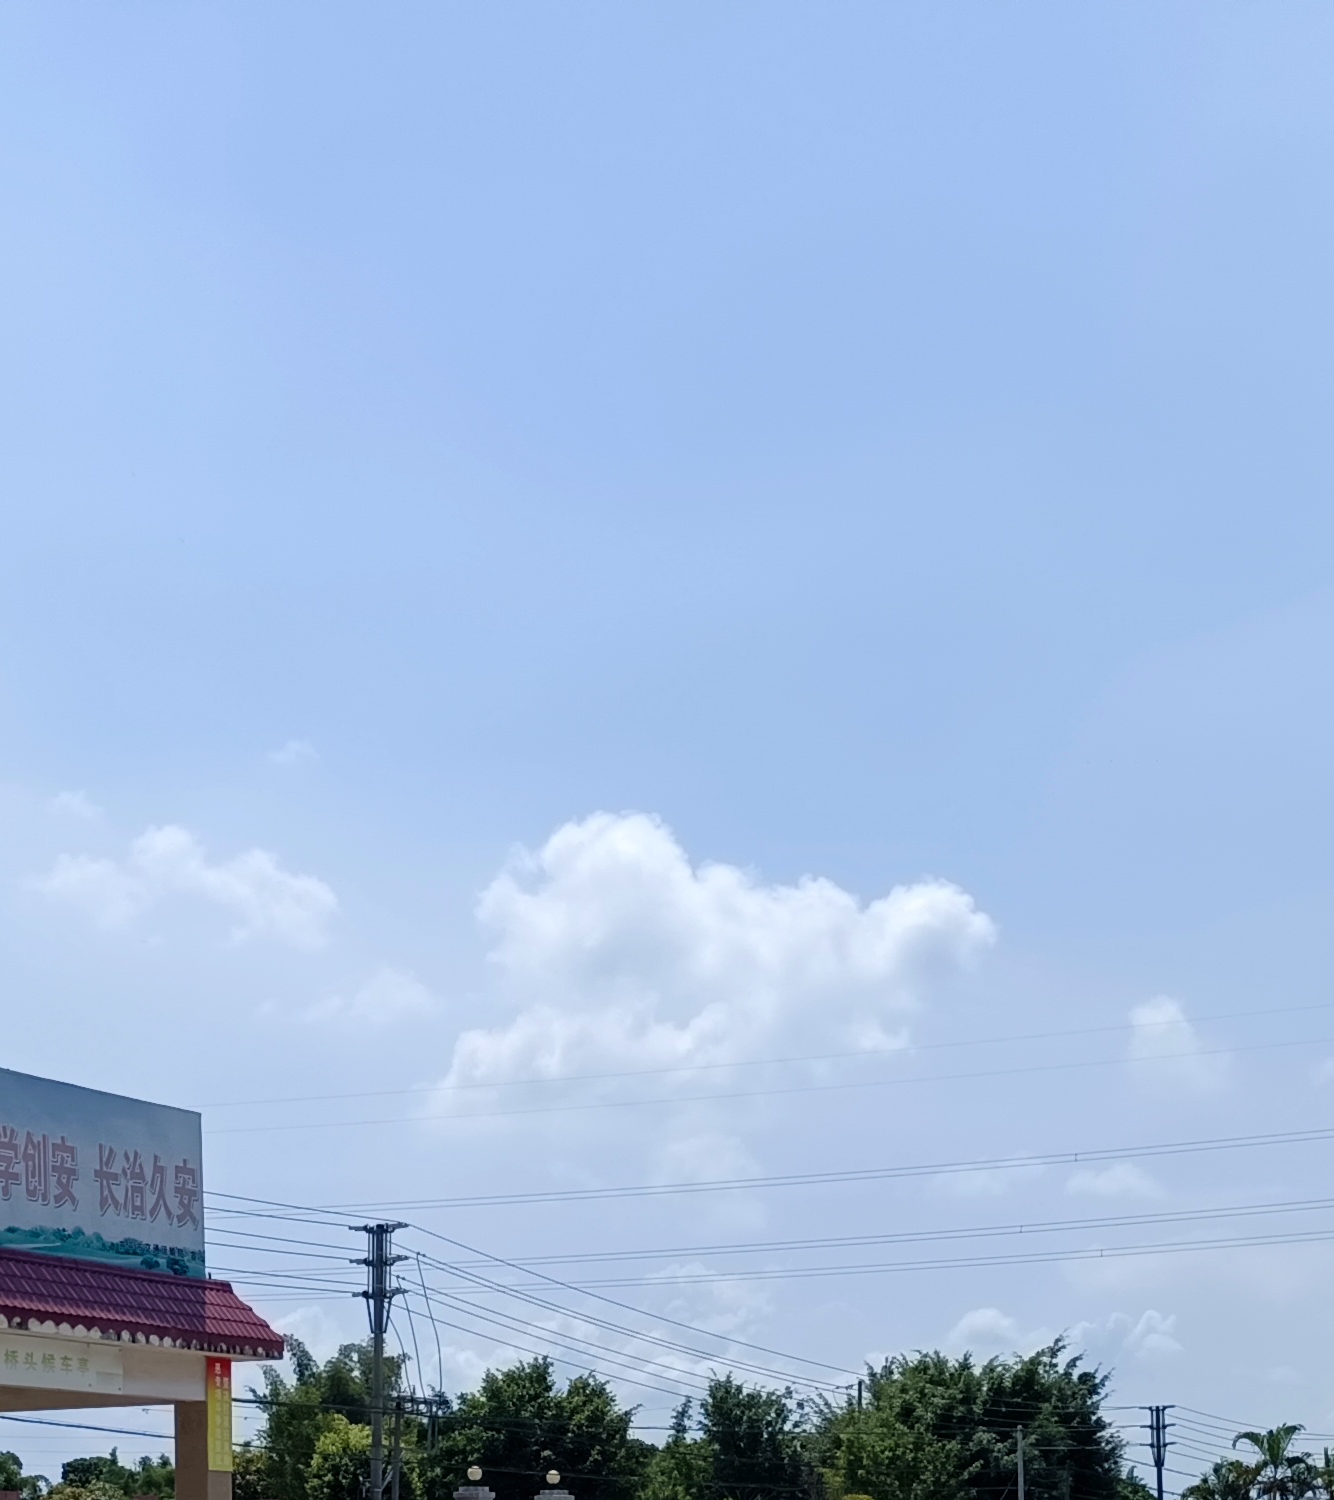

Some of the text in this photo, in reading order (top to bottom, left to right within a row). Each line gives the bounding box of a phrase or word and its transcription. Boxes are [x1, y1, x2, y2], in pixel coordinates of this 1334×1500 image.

[94, 1143, 199, 1230] 长治久安
[3, 1348, 90, 1377] 桥头候车亭
